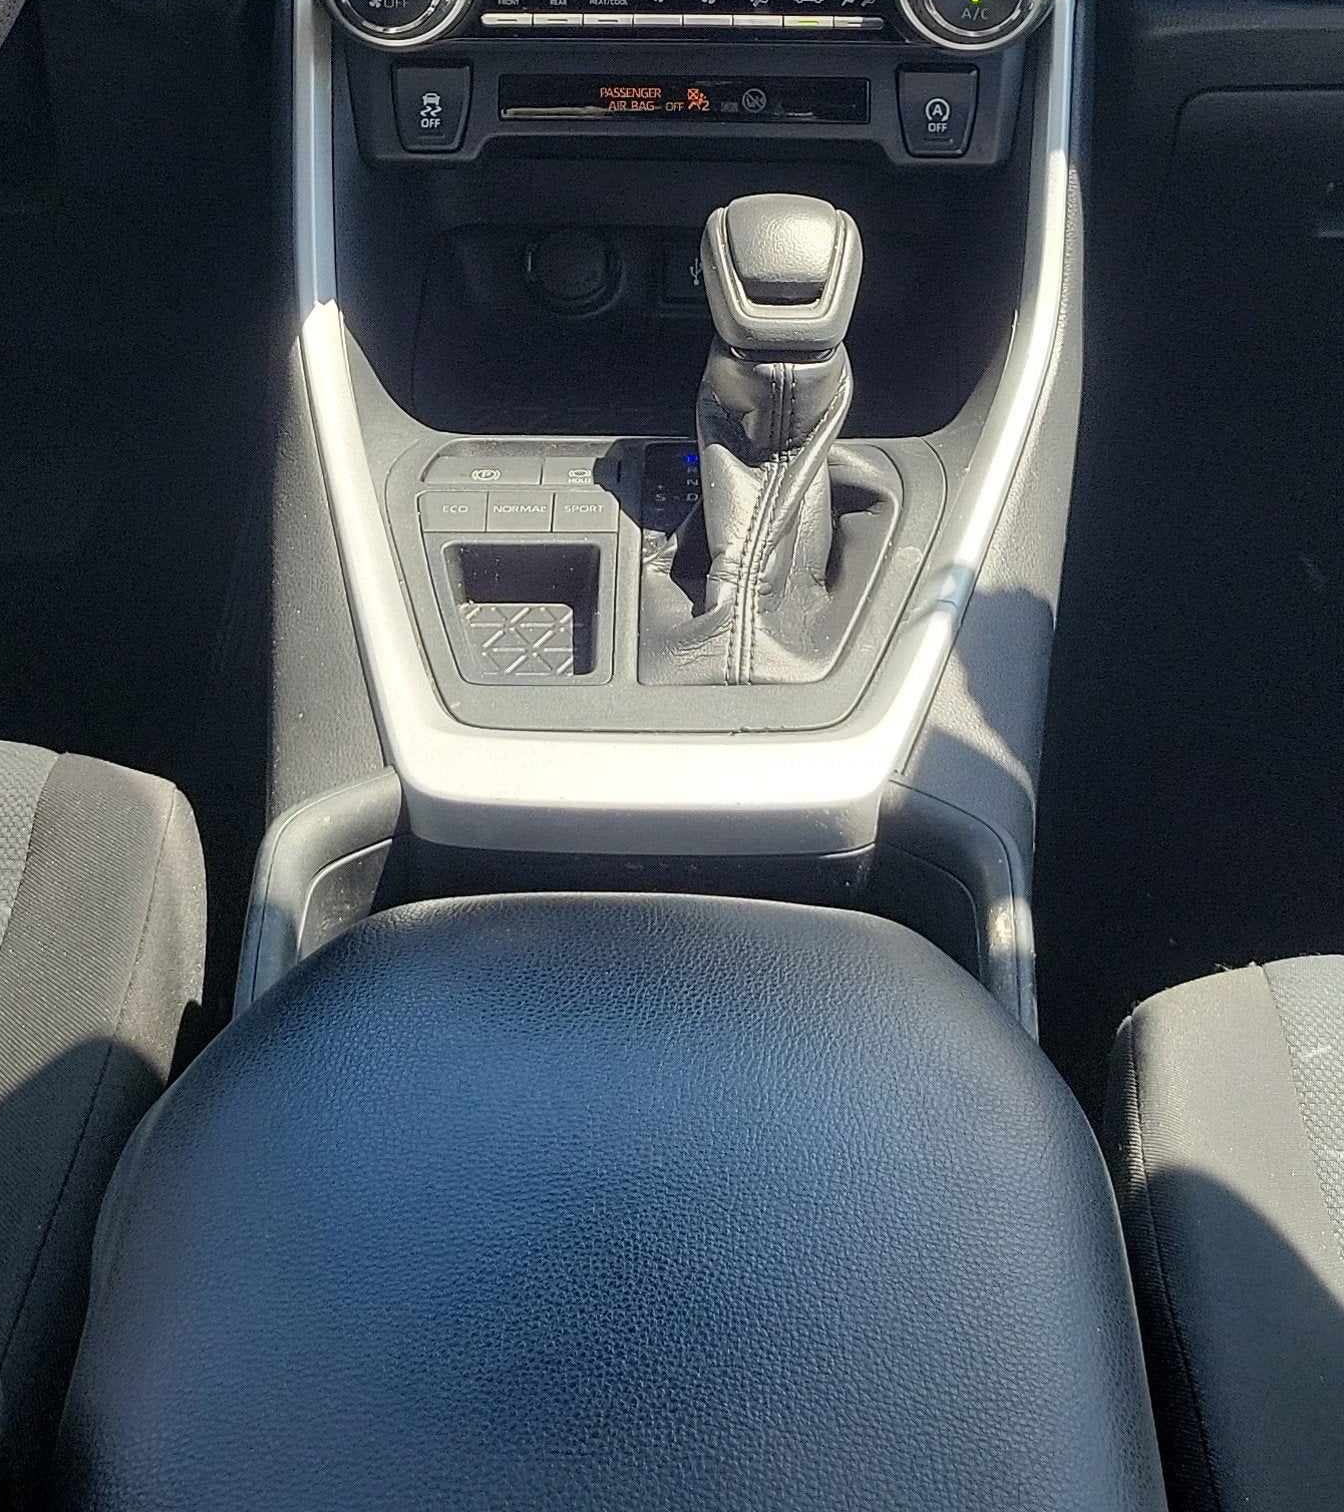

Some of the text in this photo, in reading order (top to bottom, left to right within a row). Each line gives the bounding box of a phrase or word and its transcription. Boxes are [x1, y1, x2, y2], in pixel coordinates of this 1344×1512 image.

[961, 7, 989, 20] A/C
[600, 87, 662, 98] PASSENGER
[608, 100, 685, 112] AIR BAG OFF
[420, 118, 441, 128] OFF
[928, 122, 948, 133] OFF
[443, 505, 468, 513] ECO
[493, 505, 547, 513] NORMAL
[564, 504, 604, 514] SPORT
